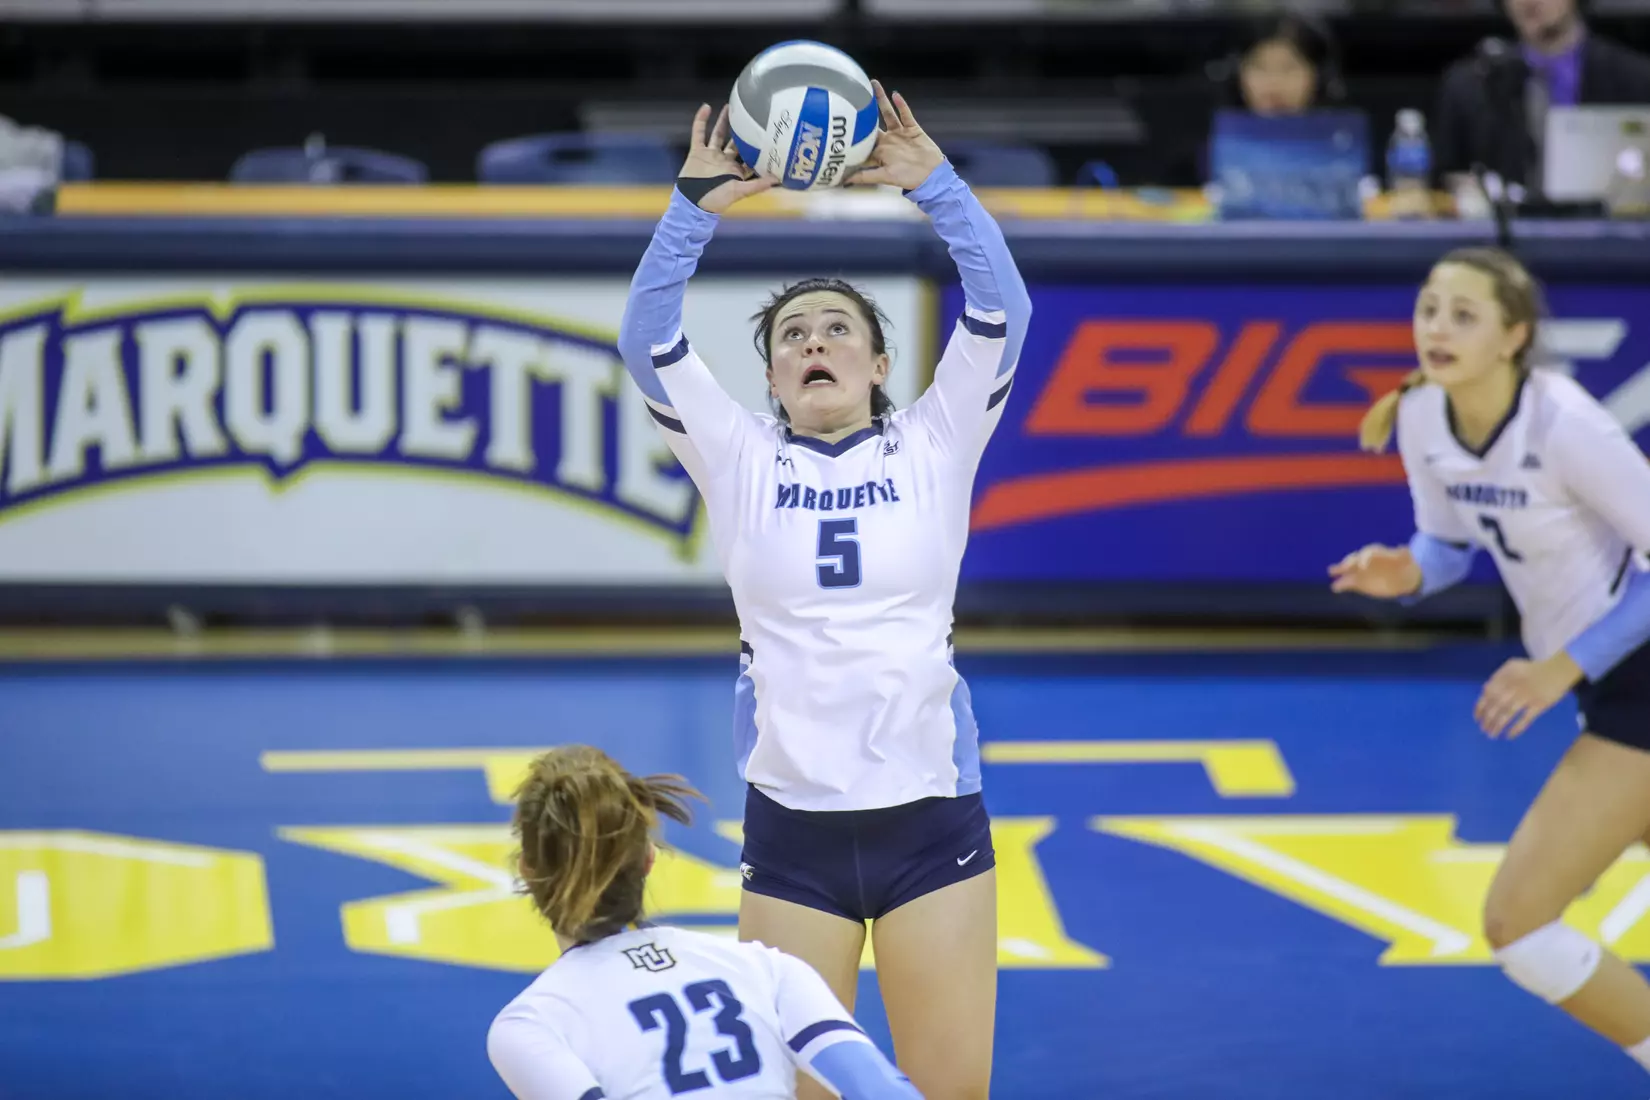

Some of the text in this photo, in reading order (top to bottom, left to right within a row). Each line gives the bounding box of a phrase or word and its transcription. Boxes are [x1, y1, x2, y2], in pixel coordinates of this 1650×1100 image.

[791, 121, 824, 182] NCAA
[816, 115, 848, 186] molten
[1023, 321, 1415, 438] BIG
[815, 517, 862, 590] 5
[621, 942, 677, 972] MU
[626, 977, 762, 1097] 23
